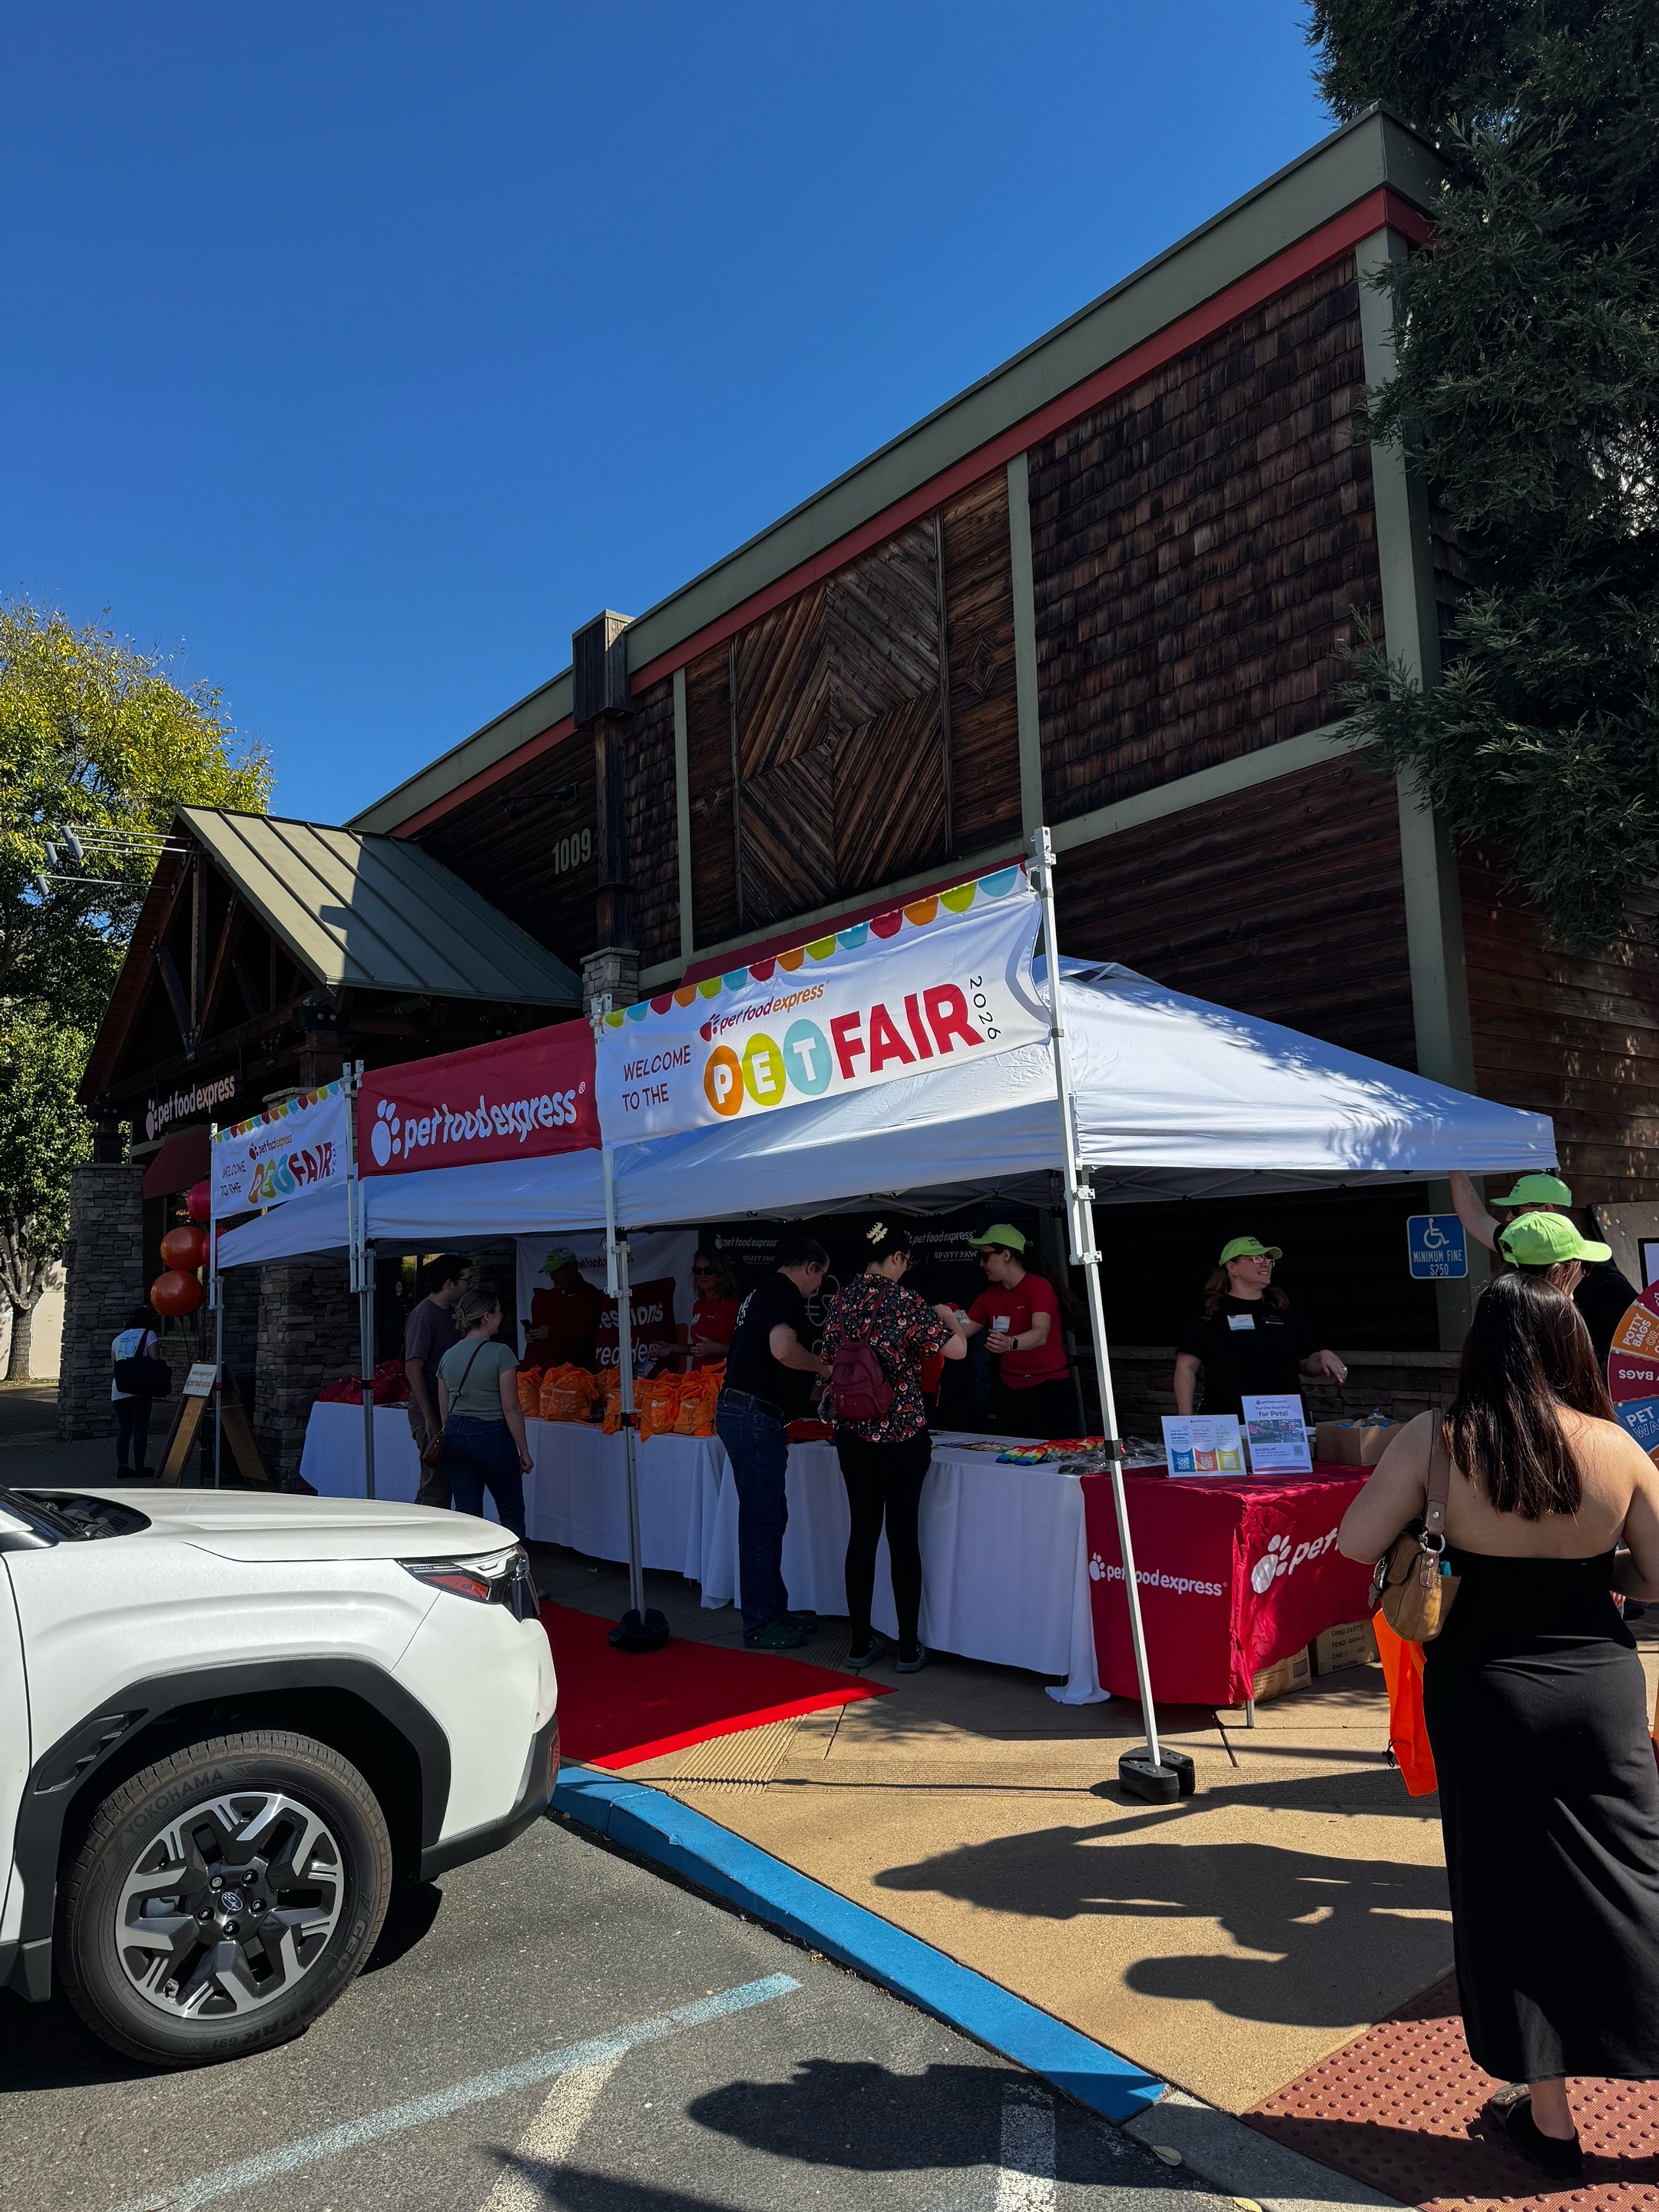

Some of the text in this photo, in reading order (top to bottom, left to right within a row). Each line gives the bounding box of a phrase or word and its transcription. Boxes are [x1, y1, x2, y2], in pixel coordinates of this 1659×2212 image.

[551, 827, 591, 875] 1009
[969, 975, 1002, 1041] 2026
[713, 983, 986, 1105] PET FAIR
[623, 1044, 692, 1082] WELCOME
[621, 1082, 670, 1112] TO THE
[288, 1141, 333, 1187] FAIR
[220, 1181, 242, 1197] TO THE
[1413, 1250, 1463, 1263] MINIMUM FINE
[1622, 1313, 1643, 1346] POTTY
[1631, 1320, 1651, 1348] BAGS
[1618, 1369, 1654, 1381] BAGS
[1625, 1406, 1654, 1428] PET
[1633, 1418, 1659, 1439] WA
[1288, 1527, 1338, 1575] pet
[1135, 1568, 1160, 1587] ood
[1159, 1575, 1223, 1597] express
[124, 1768, 224, 1836] YOKOHAMA
